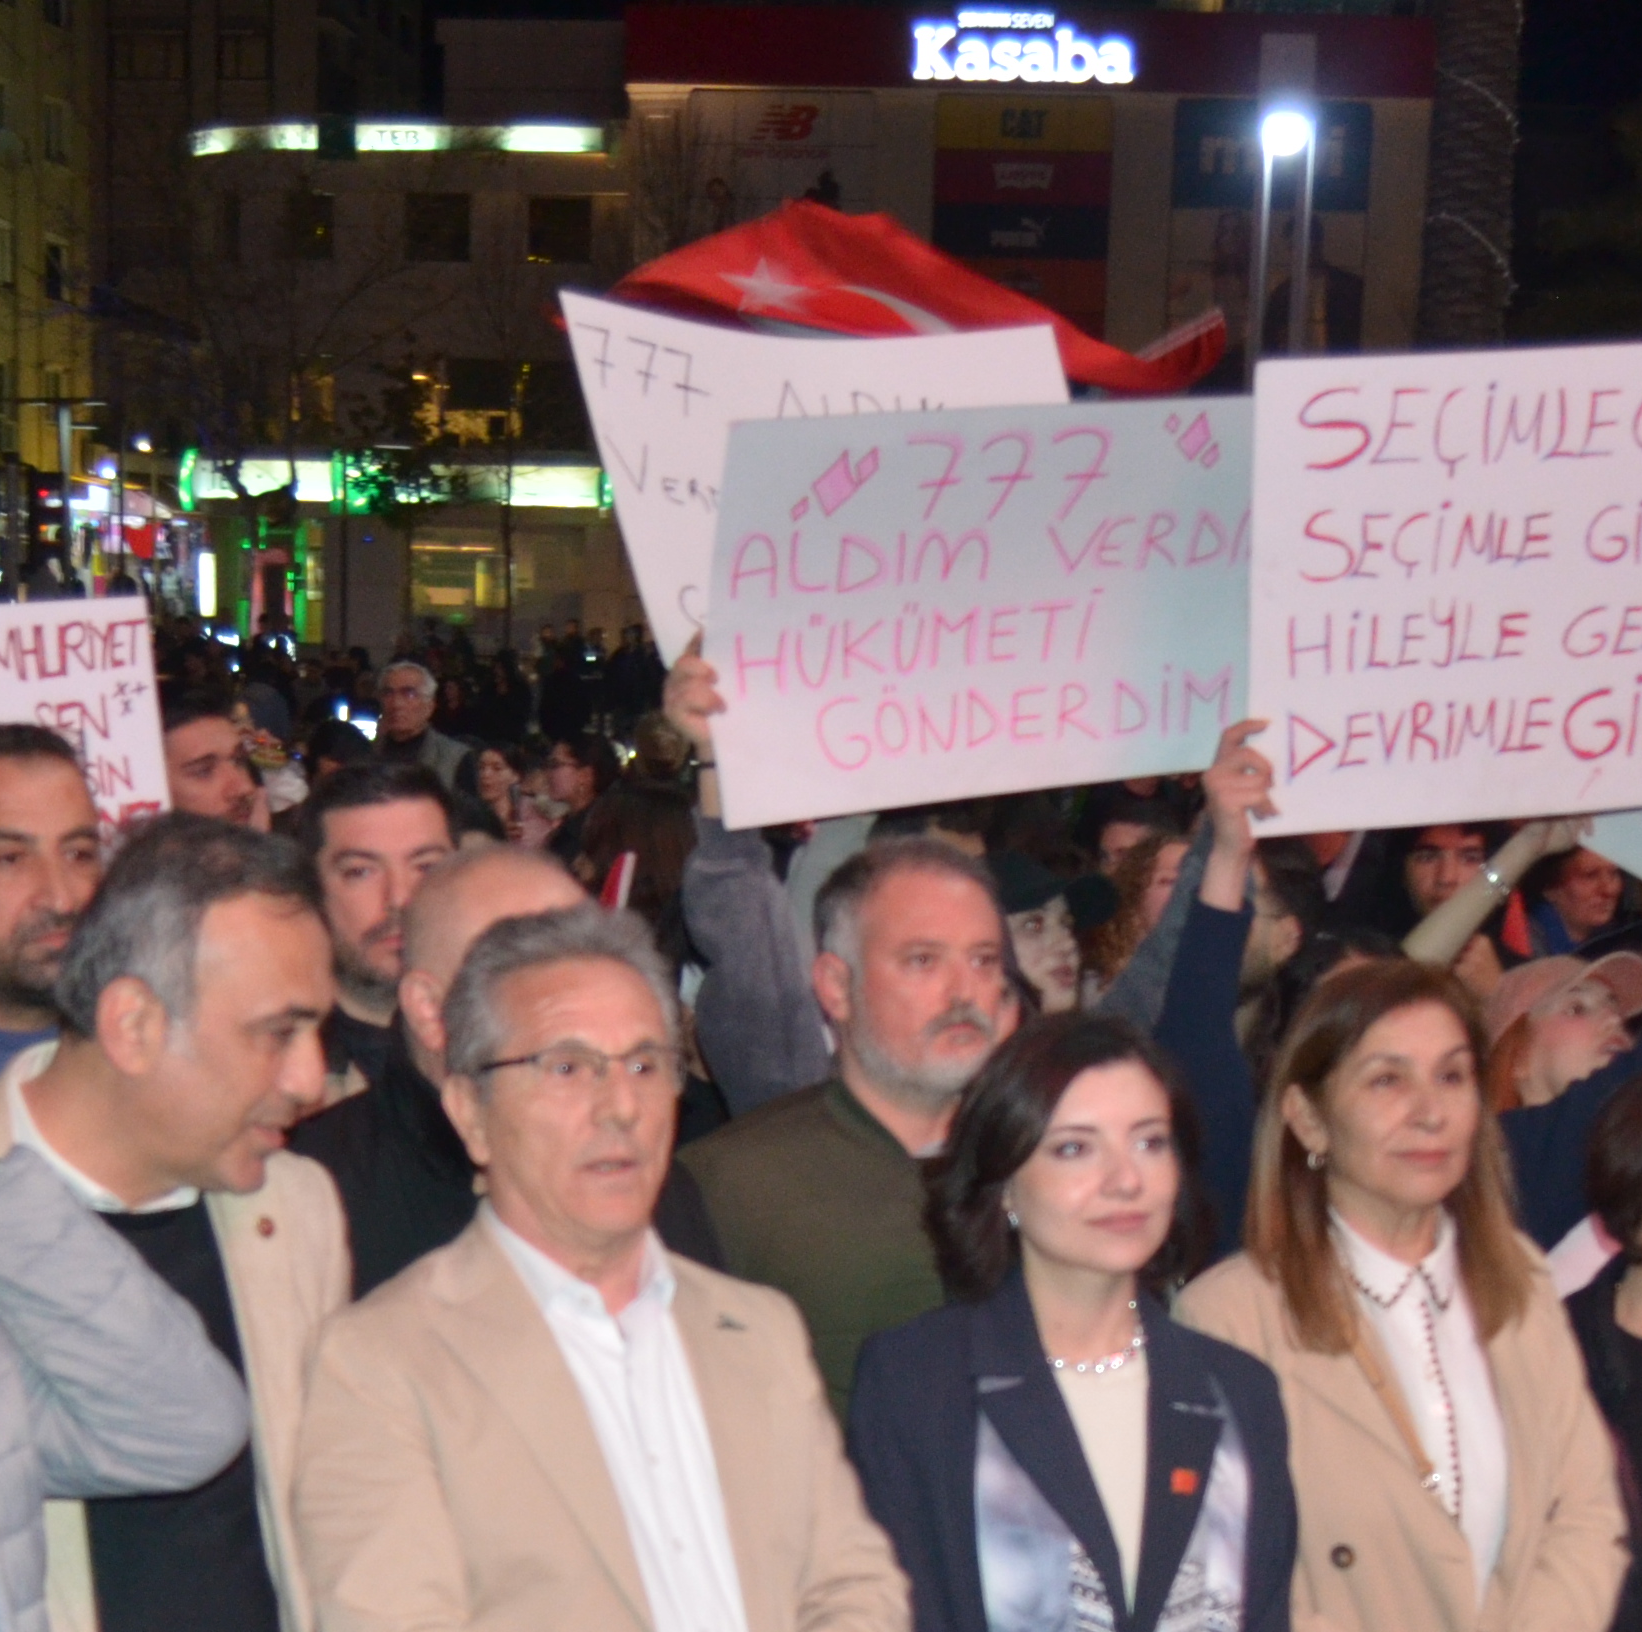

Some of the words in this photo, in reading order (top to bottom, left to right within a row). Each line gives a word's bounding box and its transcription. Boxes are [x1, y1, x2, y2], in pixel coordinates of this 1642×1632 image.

[912, 26, 1135, 84] Kasaba
[906, 426, 1114, 520] 777
[728, 529, 992, 601] ALDIM
